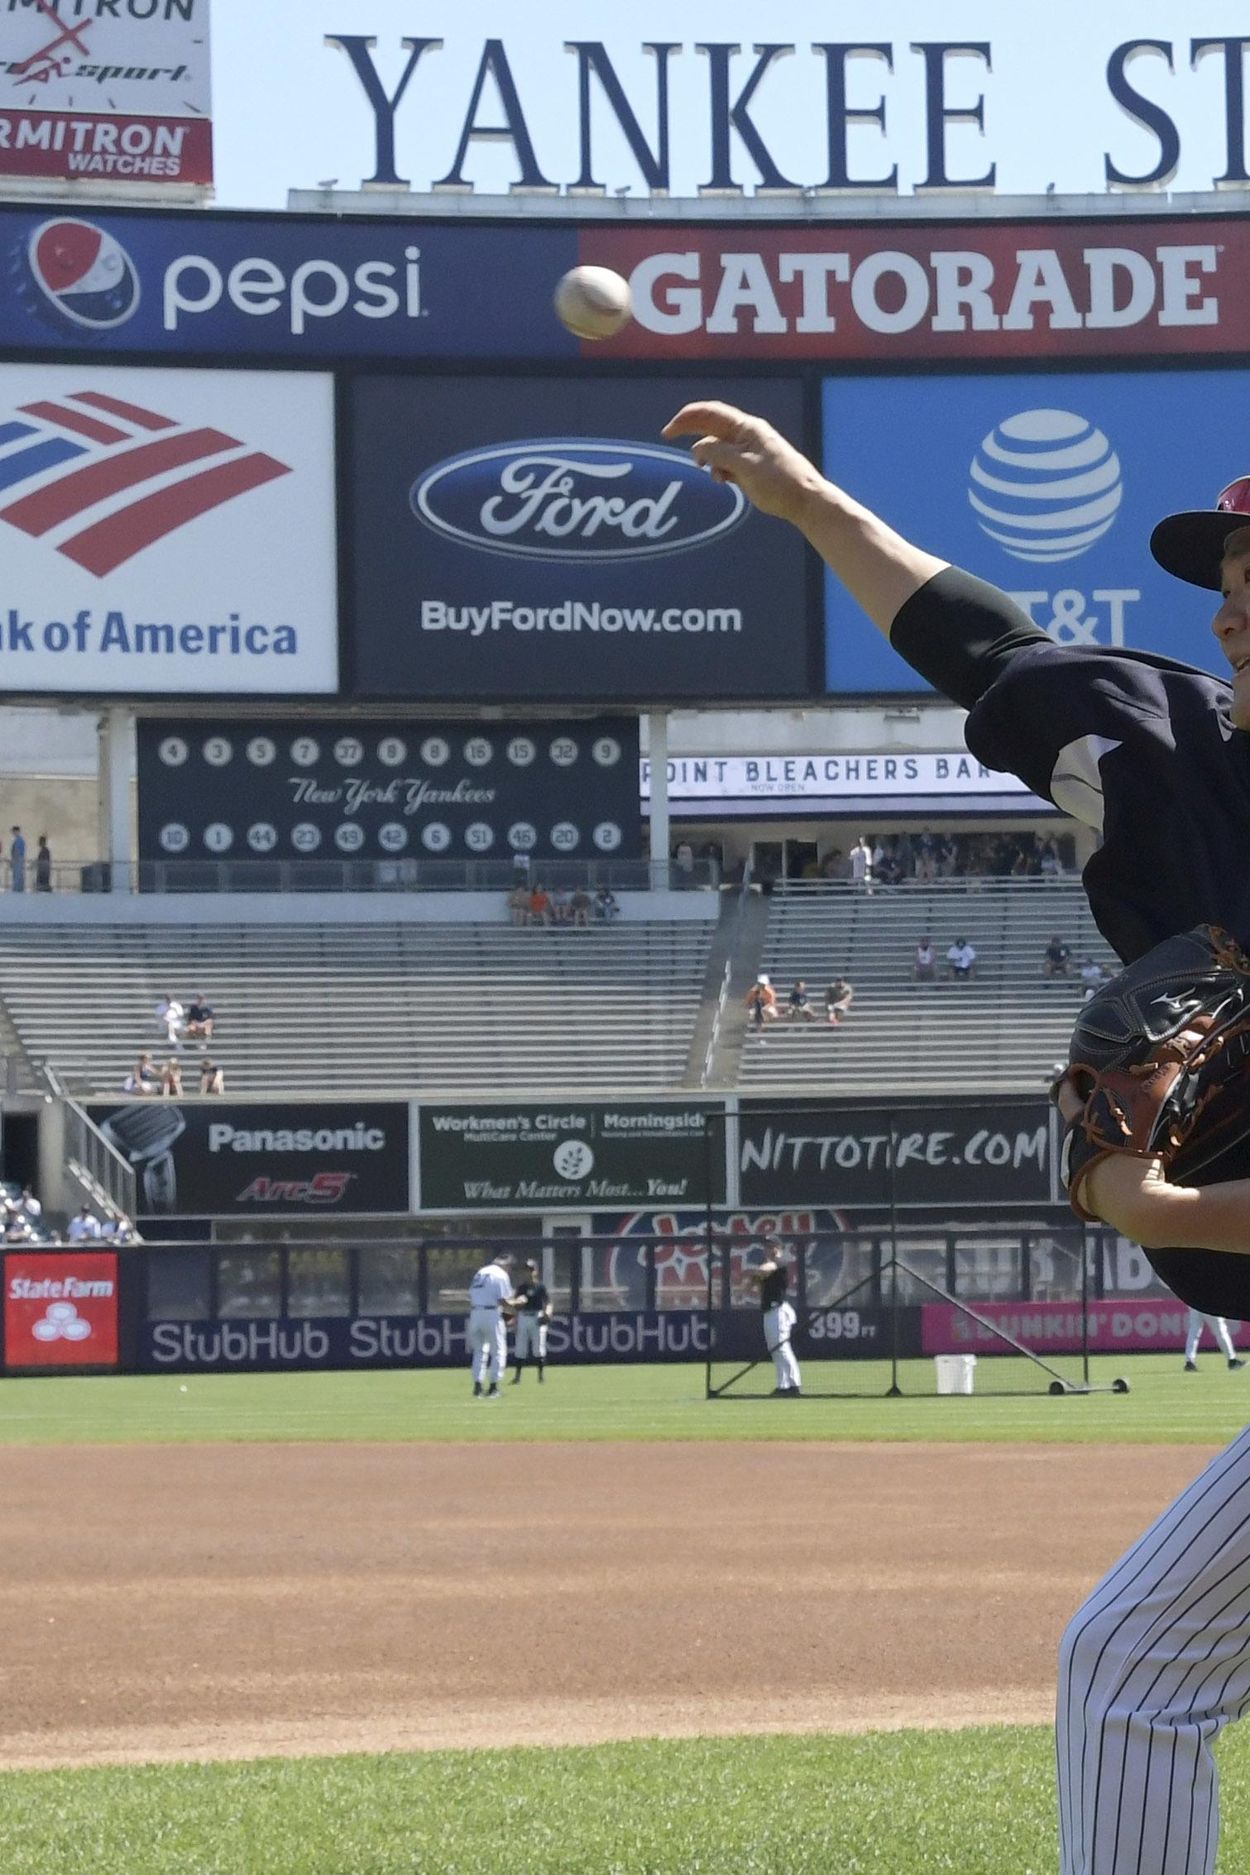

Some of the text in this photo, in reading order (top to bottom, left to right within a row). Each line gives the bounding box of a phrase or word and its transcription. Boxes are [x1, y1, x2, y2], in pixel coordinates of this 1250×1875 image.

[75, 64, 187, 84] sport
[324, 34, 997, 190] YANKEE
[68, 153, 181, 176] WATCHES
[164, 245, 421, 335] pepsi
[630, 244, 1219, 335] GATORADE
[480, 456, 684, 539] Ford
[44, 610, 91, 652] of
[101, 611, 297, 654] America
[421, 601, 742, 636] BuyFordNow.com
[514, 744, 529, 759] 15
[746, 758, 919, 782] BLEACHERS
[288, 777, 497, 815] New York Yankees
[209, 1121, 385, 1152] Panasonic
[535, 1113, 586, 1130] Circle
[741, 1126, 1047, 1172] NITTOTIRE.COM
[464, 1181, 510, 1199] What
[515, 1180, 581, 1198] Matters
[648, 1179, 688, 1197] You!
[152, 1320, 330, 1362] StubHub
[809, 1311, 860, 1339] 399
